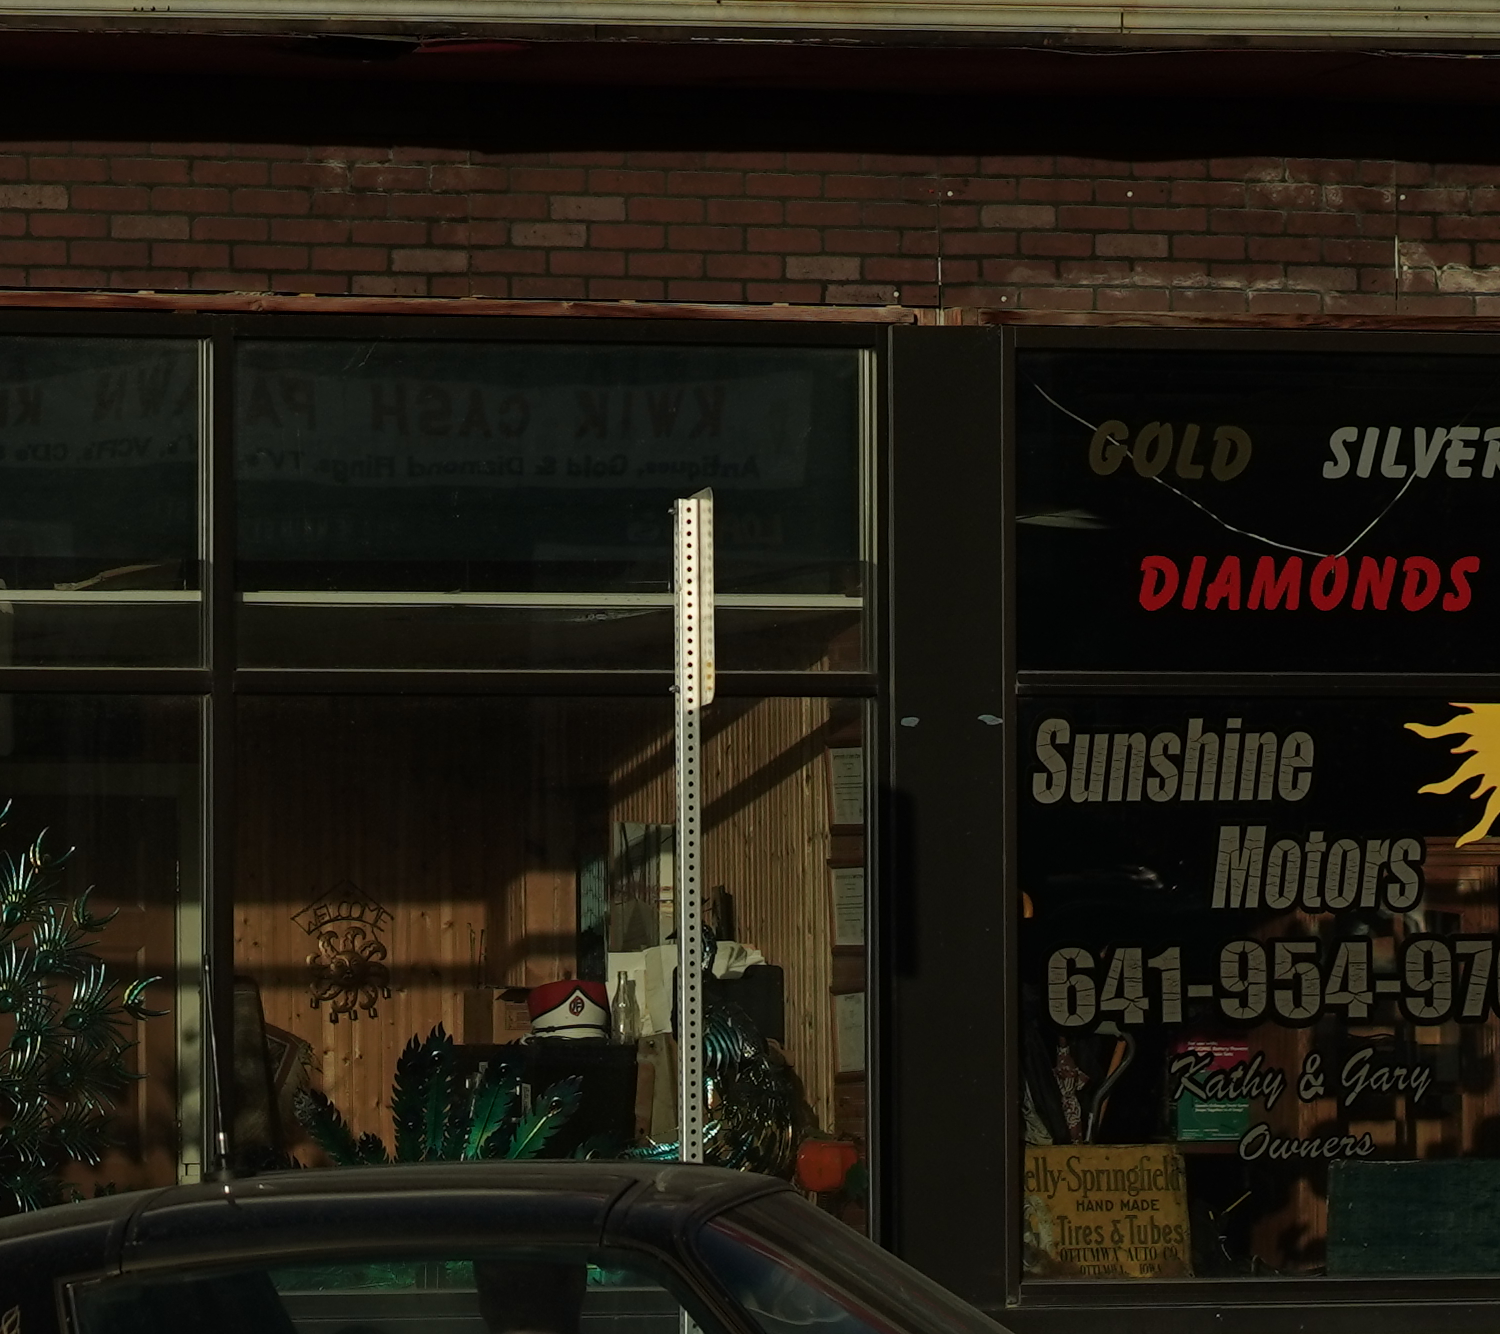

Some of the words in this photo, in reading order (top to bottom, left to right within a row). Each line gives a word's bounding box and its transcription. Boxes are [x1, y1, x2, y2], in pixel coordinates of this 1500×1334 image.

[1087, 419, 1254, 482] GOLD
[1136, 554, 1481, 614] DIAMONDS
[1031, 717, 1316, 805] Sunshine
[1211, 825, 1424, 910] Motors
[308, 901, 388, 930] WELCOME
[1171, 1052, 1284, 1107] Kathy
[1300, 1053, 1326, 1101] &
[1341, 1048, 1433, 1104] Gary
[1239, 1122, 1376, 1162] Owners
[1024, 1155, 1181, 1200] elly-Springfield
[1076, 1199, 1114, 1212] HAND
[1120, 1199, 1160, 1212] MADE
[1056, 1215, 1105, 1246] Tires
[1110, 1219, 1125, 1246] &
[1124, 1215, 1184, 1246] Tubes
[1126, 1246, 1158, 1262] AUTO
